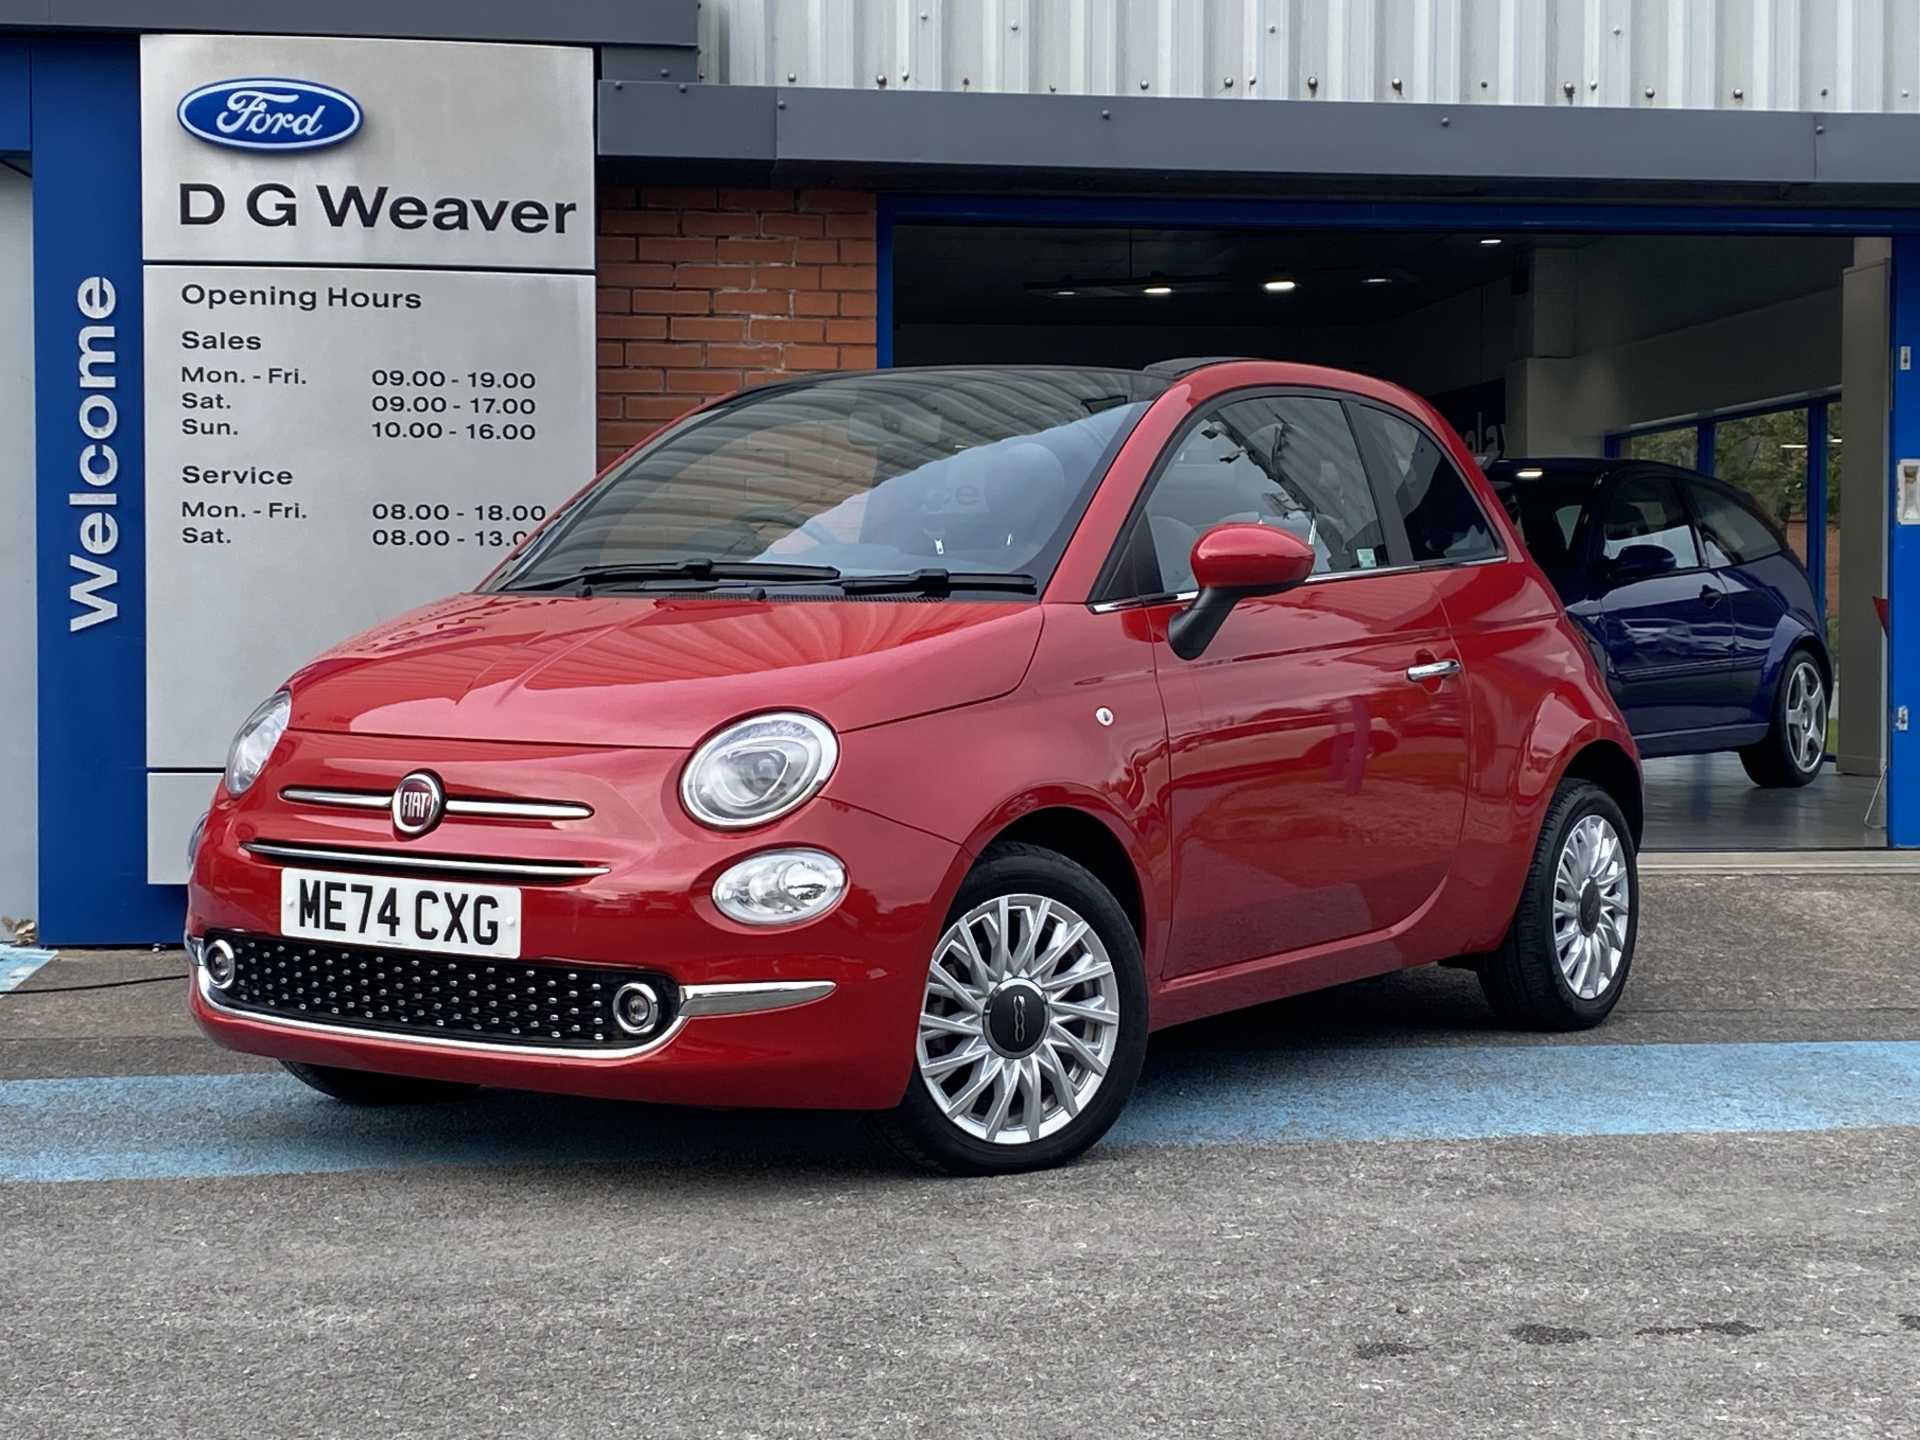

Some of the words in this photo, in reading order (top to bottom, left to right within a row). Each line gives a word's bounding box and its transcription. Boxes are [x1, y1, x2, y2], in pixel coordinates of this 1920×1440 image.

[215, 89, 324, 135] Ford
[179, 183, 225, 225] D
[246, 183, 297, 227] G
[316, 185, 577, 234] Weaver
[181, 284, 317, 312] Opening
[328, 287, 422, 309] Hours
[181, 330, 262, 351] Sales
[372, 369, 446, 387] 09.00
[467, 372, 536, 389] 19.00
[182, 392, 231, 409] Sat.
[372, 395, 447, 413] 09.00
[470, 397, 536, 415] 17.00
[182, 418, 238, 436] Sun.
[372, 421, 443, 439] 10.00
[466, 423, 536, 441] 16.00
[69, 276, 119, 632] Welcome
[182, 465, 293, 485] Service
[372, 503, 450, 521] 08.00
[474, 505, 546, 522] 18.00
[182, 527, 231, 544] Sat.
[372, 529, 450, 546] 08.00
[474, 530, 528, 547] 13.0
[402, 791, 431, 818] FIAT
[299, 878, 400, 937] ME74
[415, 890, 499, 945] CXG
